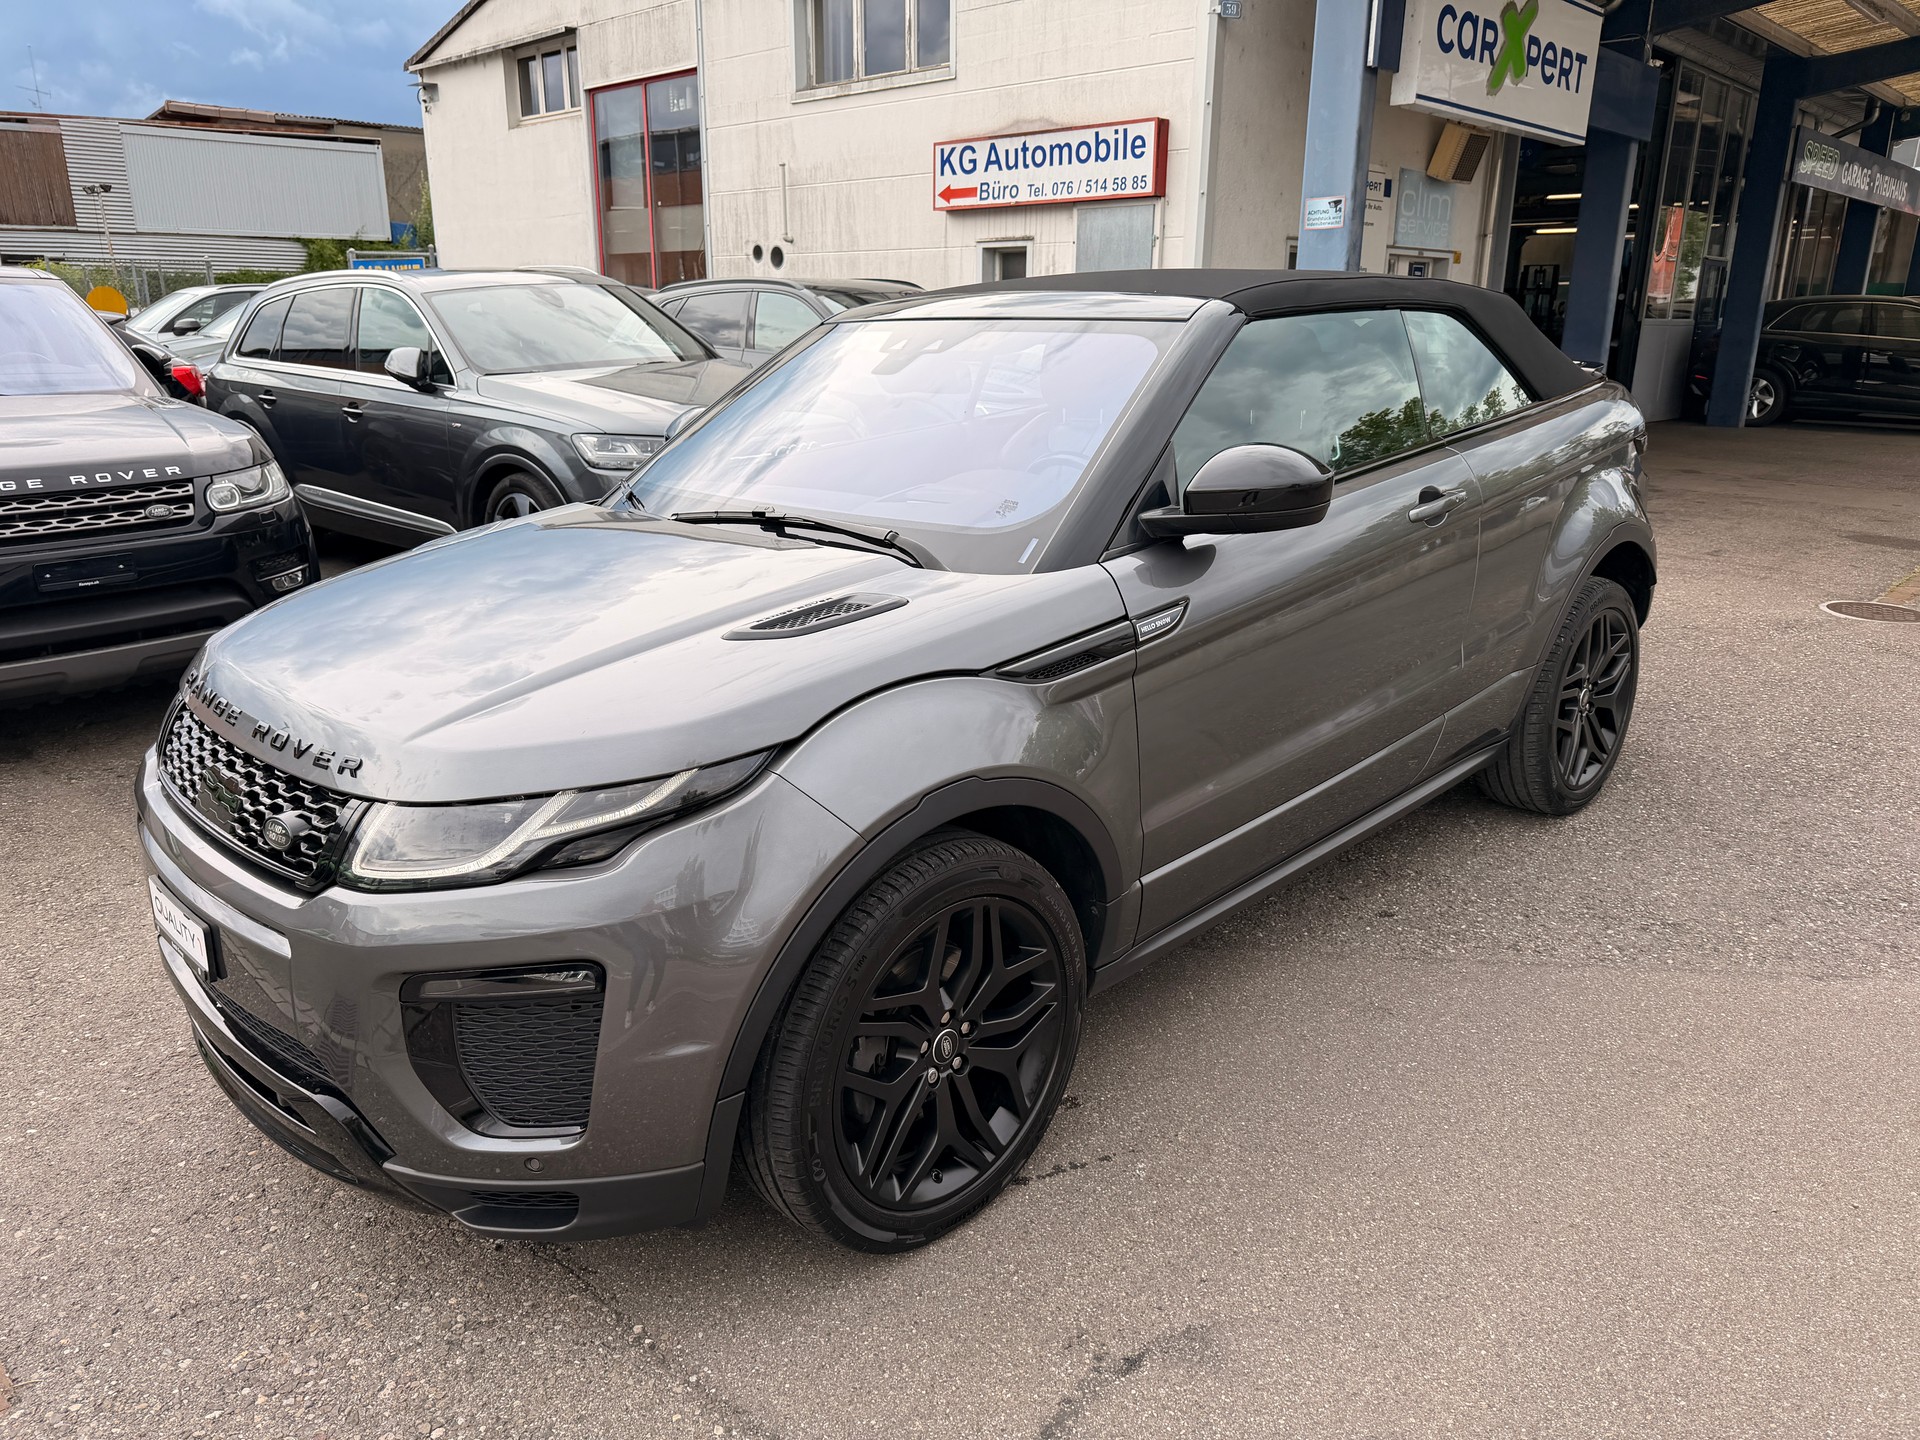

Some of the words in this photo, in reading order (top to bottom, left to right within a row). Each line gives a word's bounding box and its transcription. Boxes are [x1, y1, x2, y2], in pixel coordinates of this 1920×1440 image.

[1226, 4, 1237, 15] 39
[940, 145, 977, 176] KG
[984, 128, 1146, 172] Automobile
[1799, 140, 1840, 180] SPEED
[1841, 161, 1872, 191] GARAGE
[1873, 172, 1909, 202] PNEUHAUS
[979, 181, 1019, 201] Büro
[1027, 184, 1048, 197] Tel.
[1052, 180, 1074, 195] 076
[1085, 177, 1107, 193] 514
[1112, 176, 1128, 192] 58
[1131, 174, 1147, 190] 85
[1398, 218, 1449, 237] service
[69, 465, 182, 486] ROVER
[185, 668, 243, 727] RANGE
[251, 720, 363, 779] ROVER
